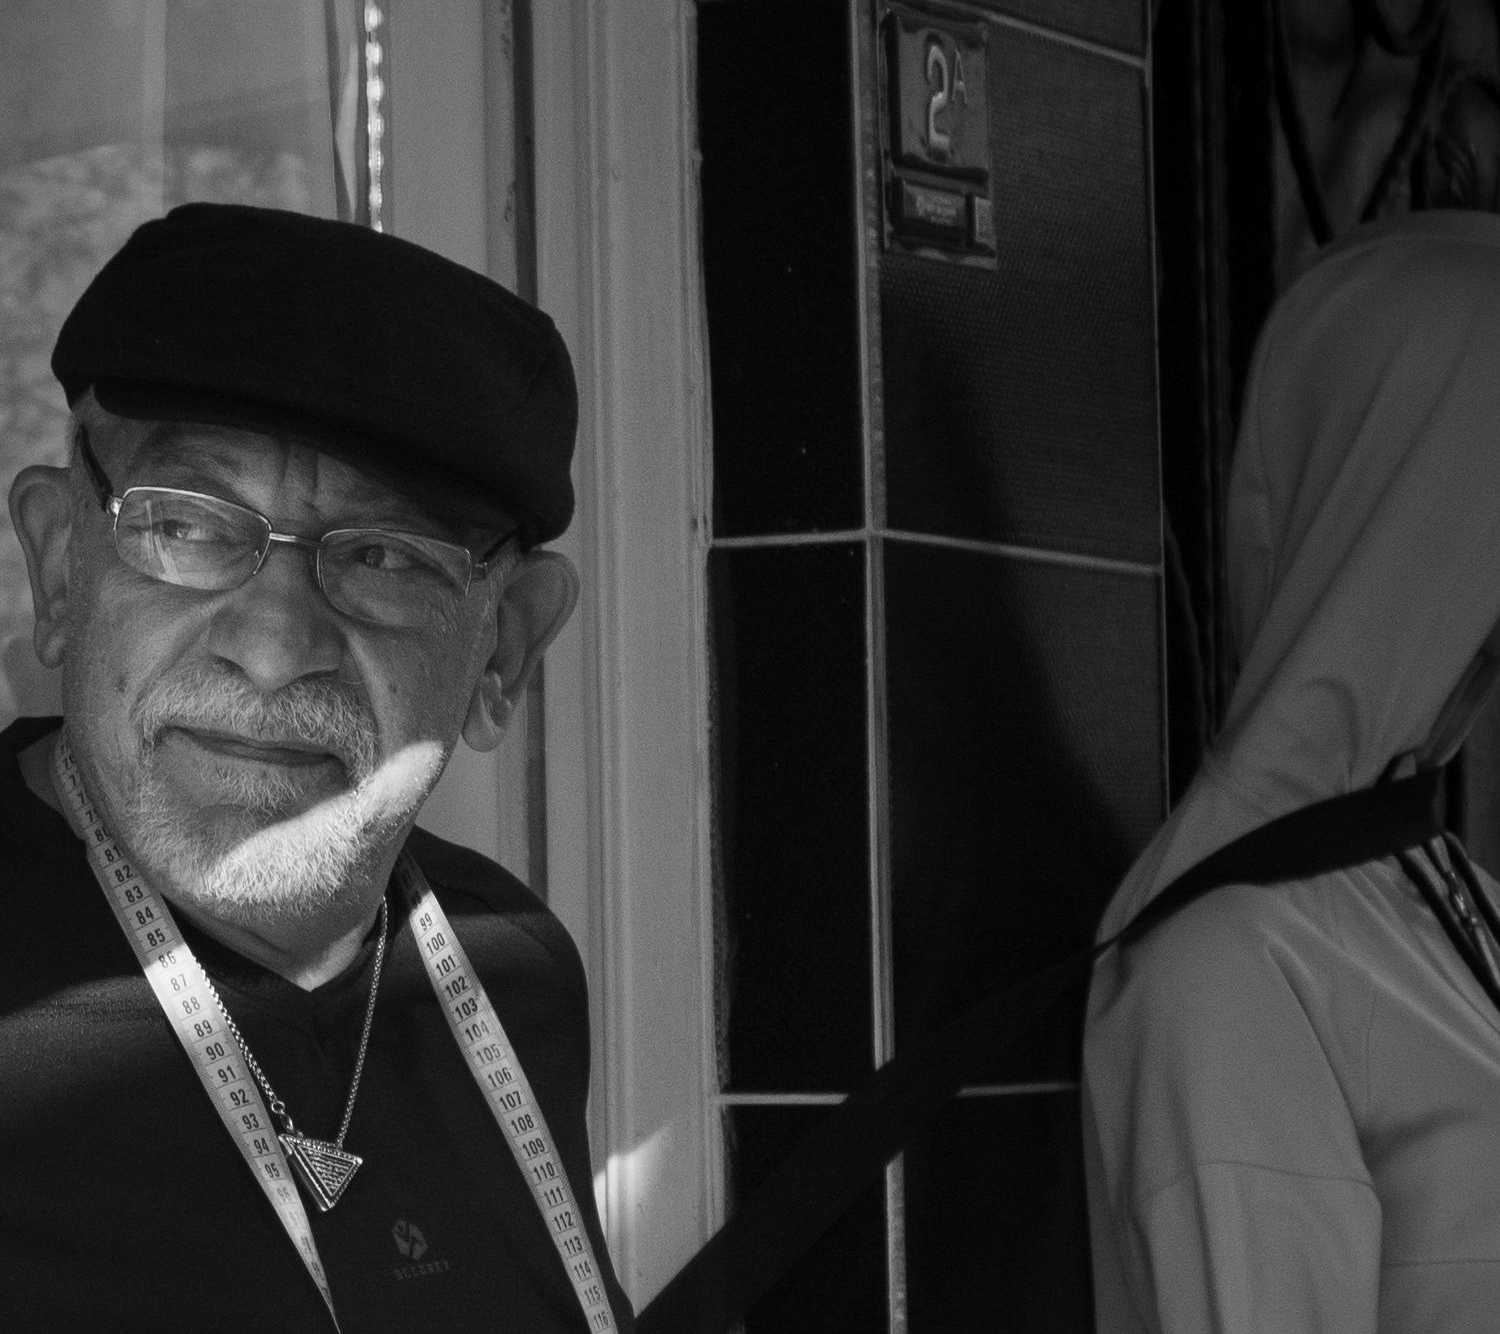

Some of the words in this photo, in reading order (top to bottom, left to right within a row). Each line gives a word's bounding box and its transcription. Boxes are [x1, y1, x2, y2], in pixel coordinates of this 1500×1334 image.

[104, 845, 124, 863] 81
[114, 864, 133, 882] 82
[125, 885, 143, 903] 83
[136, 906, 154, 927] 84
[419, 913, 433, 931] 99
[147, 928, 166, 947] 85
[426, 932, 445, 954] 100
[158, 950, 176, 968] 86
[436, 954, 456, 976] 101
[170, 973, 187, 992] 87
[445, 976, 468, 998] 102
[182, 996, 200, 1014] 88
[455, 997, 478, 1020] 103
[194, 1020, 212, 1038] 89
[465, 1020, 490, 1043] 104
[206, 1042, 225, 1060] 90
[476, 1043, 501, 1064] 105
[218, 1065, 236, 1083] 91
[488, 1067, 512, 1087] 106
[230, 1089, 249, 1107] 92
[499, 1091, 522, 1111] 107
[242, 1113, 259, 1130] 93
[511, 1114, 534, 1134] 108
[253, 1137, 270, 1155] 94
[522, 1137, 545, 1158] 109
[264, 1162, 280, 1179] 95
[533, 1161, 555, 1182] 110
[544, 1186, 567, 1208] 111
[554, 1211, 574, 1231] 112
[564, 1236, 583, 1255] 113
[574, 1260, 592, 1280] 114
[584, 1285, 601, 1306] 115
[593, 1310, 610, 1331] 116
